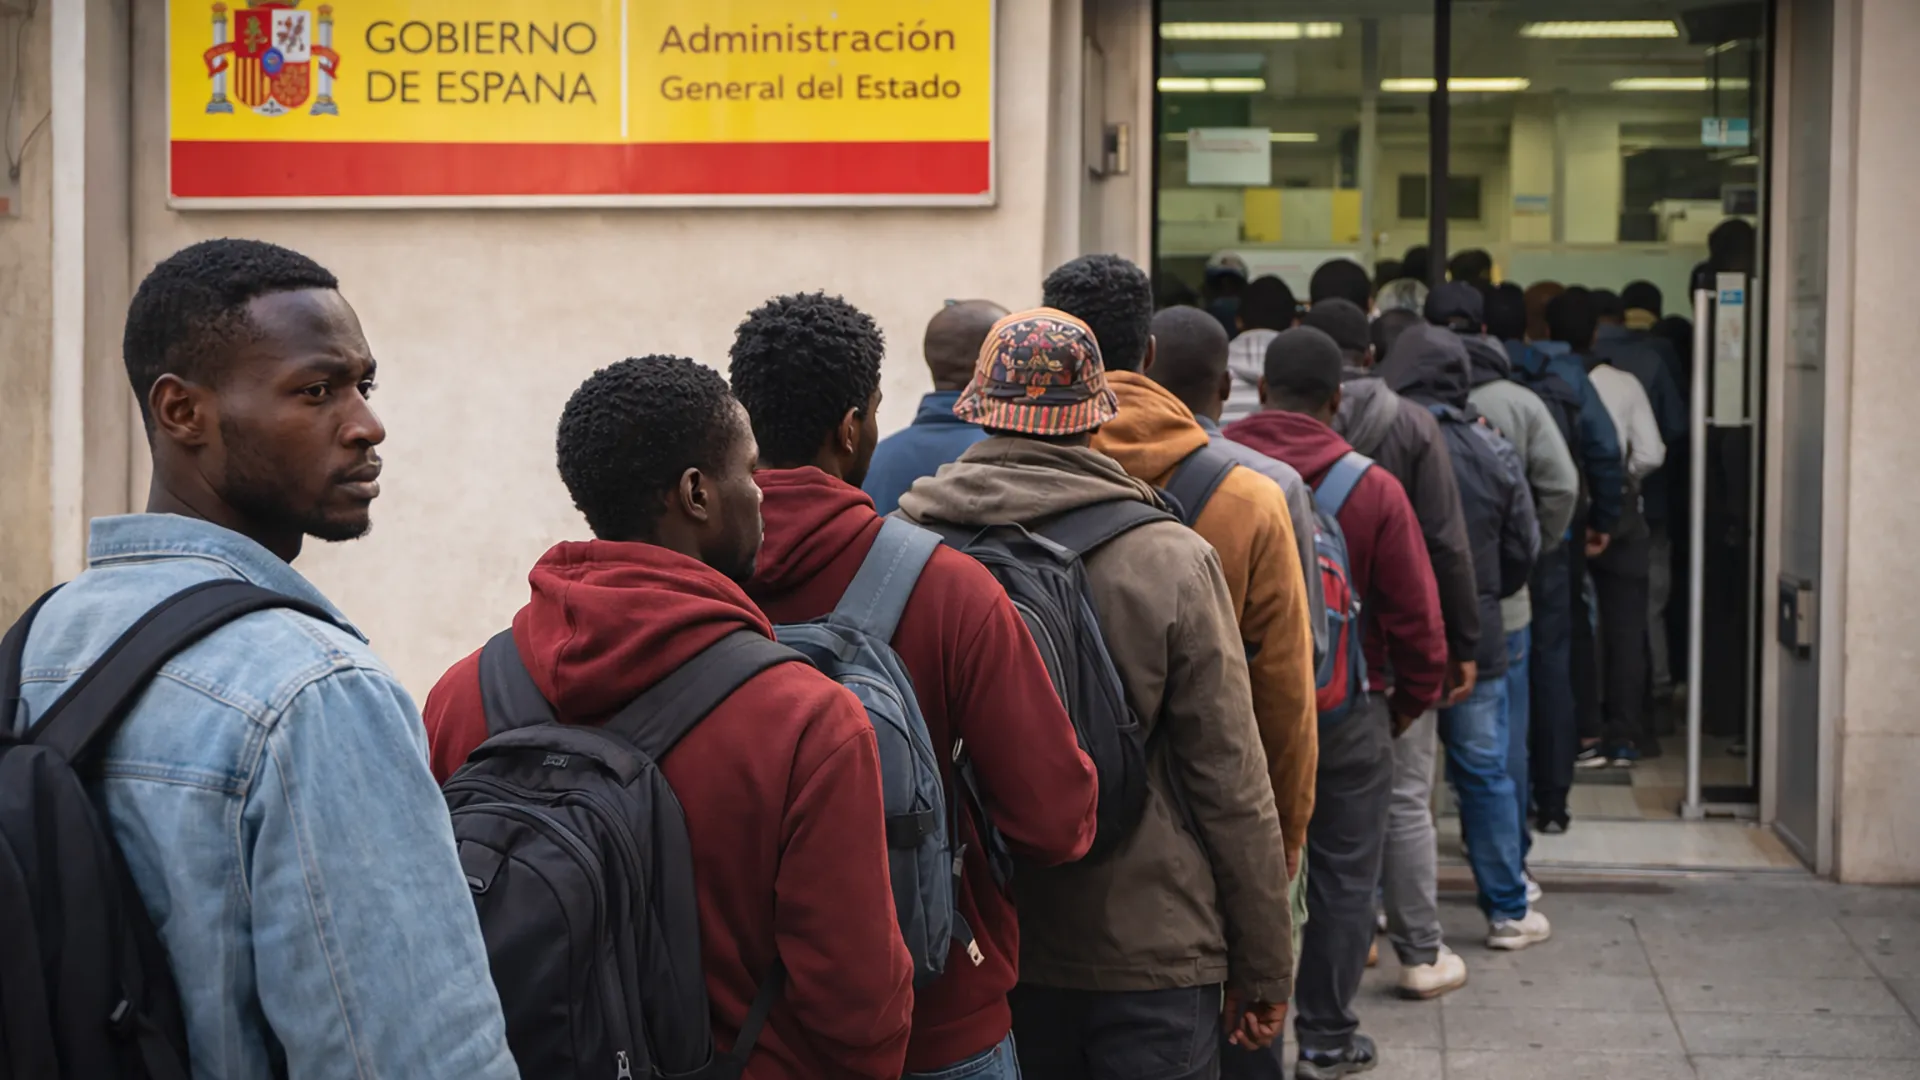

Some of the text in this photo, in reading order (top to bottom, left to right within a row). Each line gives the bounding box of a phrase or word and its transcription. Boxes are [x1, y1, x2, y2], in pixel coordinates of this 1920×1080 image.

[365, 20, 597, 55] GOBIERNO
[659, 19, 956, 54] Administración
[367, 70, 420, 103] DE
[660, 73, 961, 101] General del Estado
